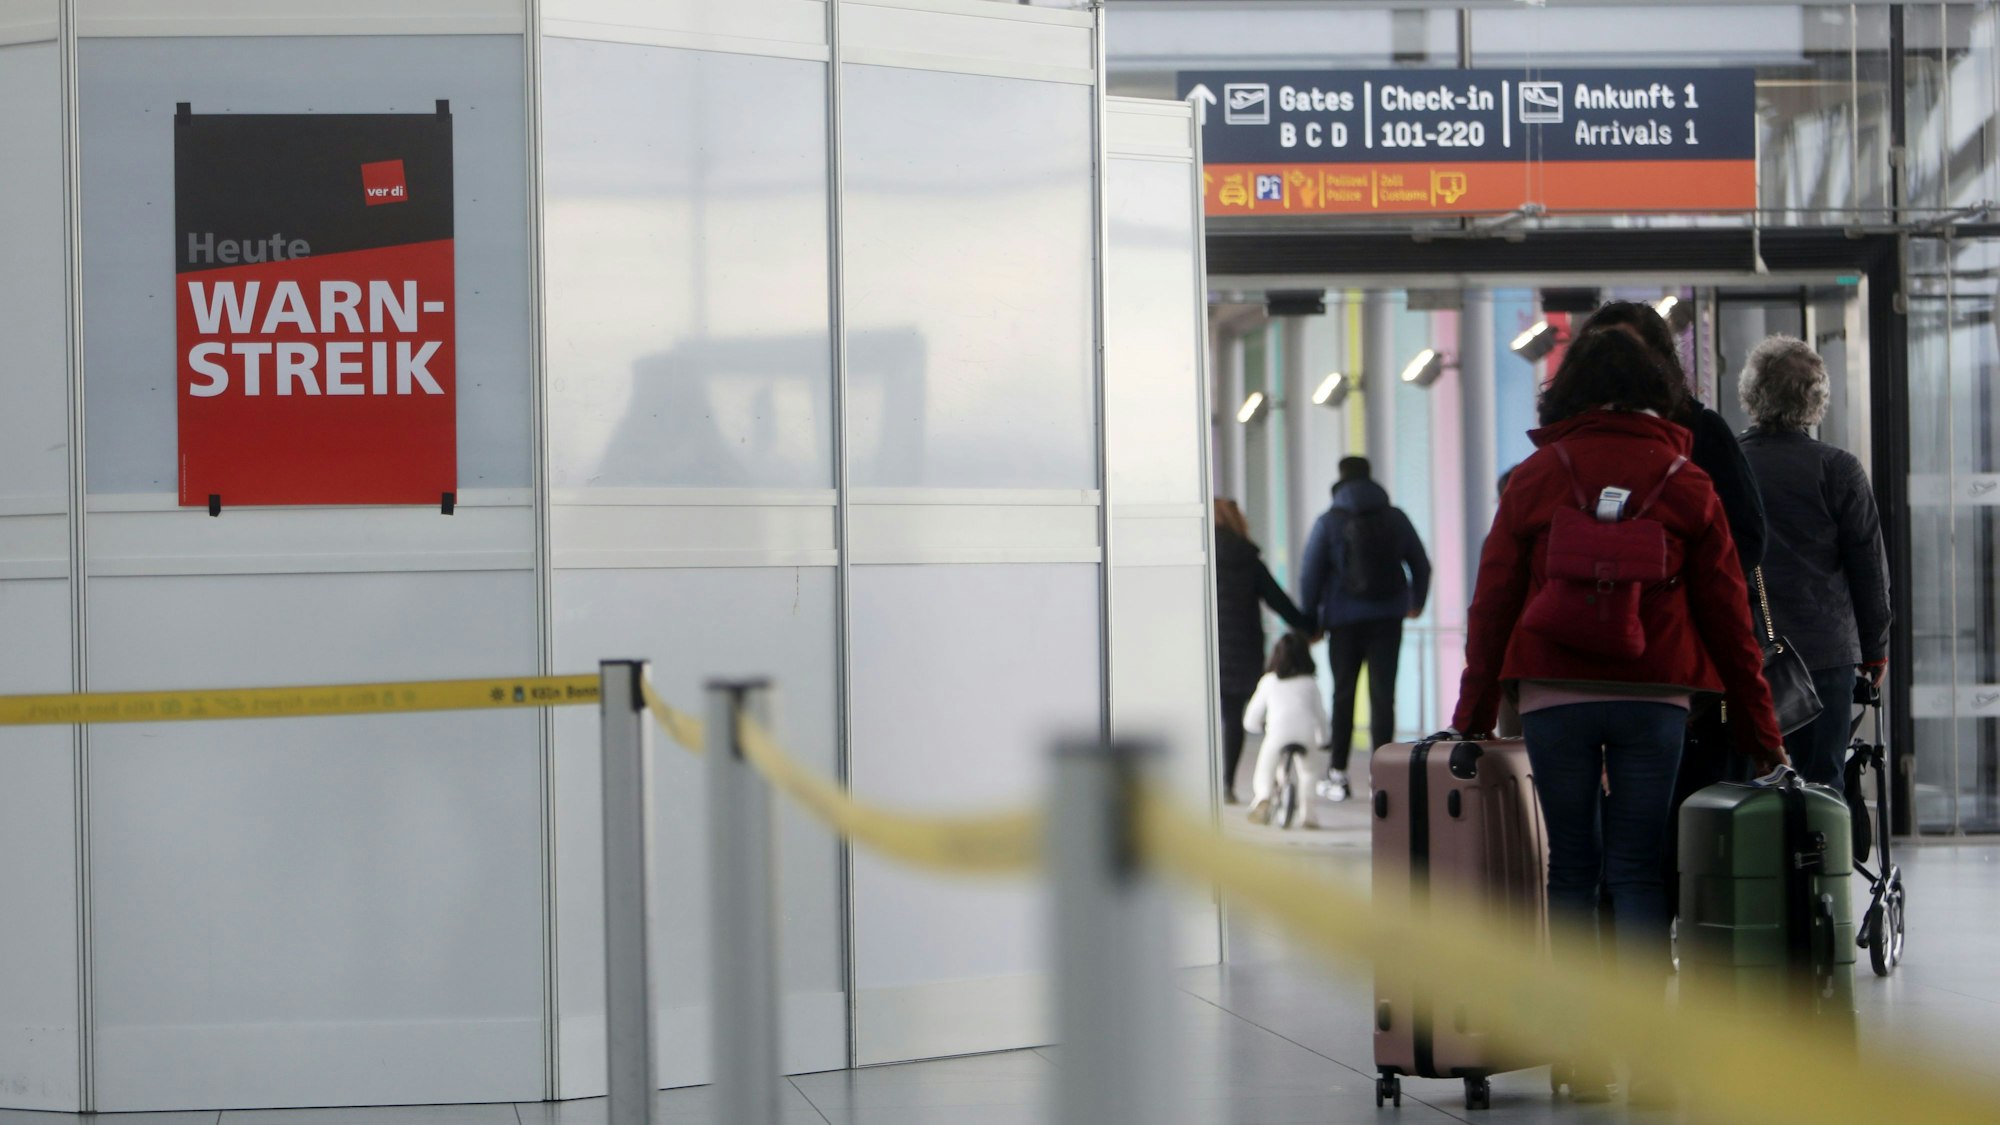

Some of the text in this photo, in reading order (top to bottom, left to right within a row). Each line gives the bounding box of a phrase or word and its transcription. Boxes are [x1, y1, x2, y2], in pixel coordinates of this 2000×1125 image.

[1279, 85, 1354, 112] Gates
[1381, 84, 1494, 111] Check-in
[1574, 82, 1698, 109] Ankunft 1
[1280, 122, 1348, 148] B C D
[1381, 121, 1485, 147] 101-220
[1574, 119, 1698, 146] Arrivals 1
[188, 232, 311, 264] Heute
[187, 280, 445, 335] WARN-
[187, 341, 446, 398] STREIK
